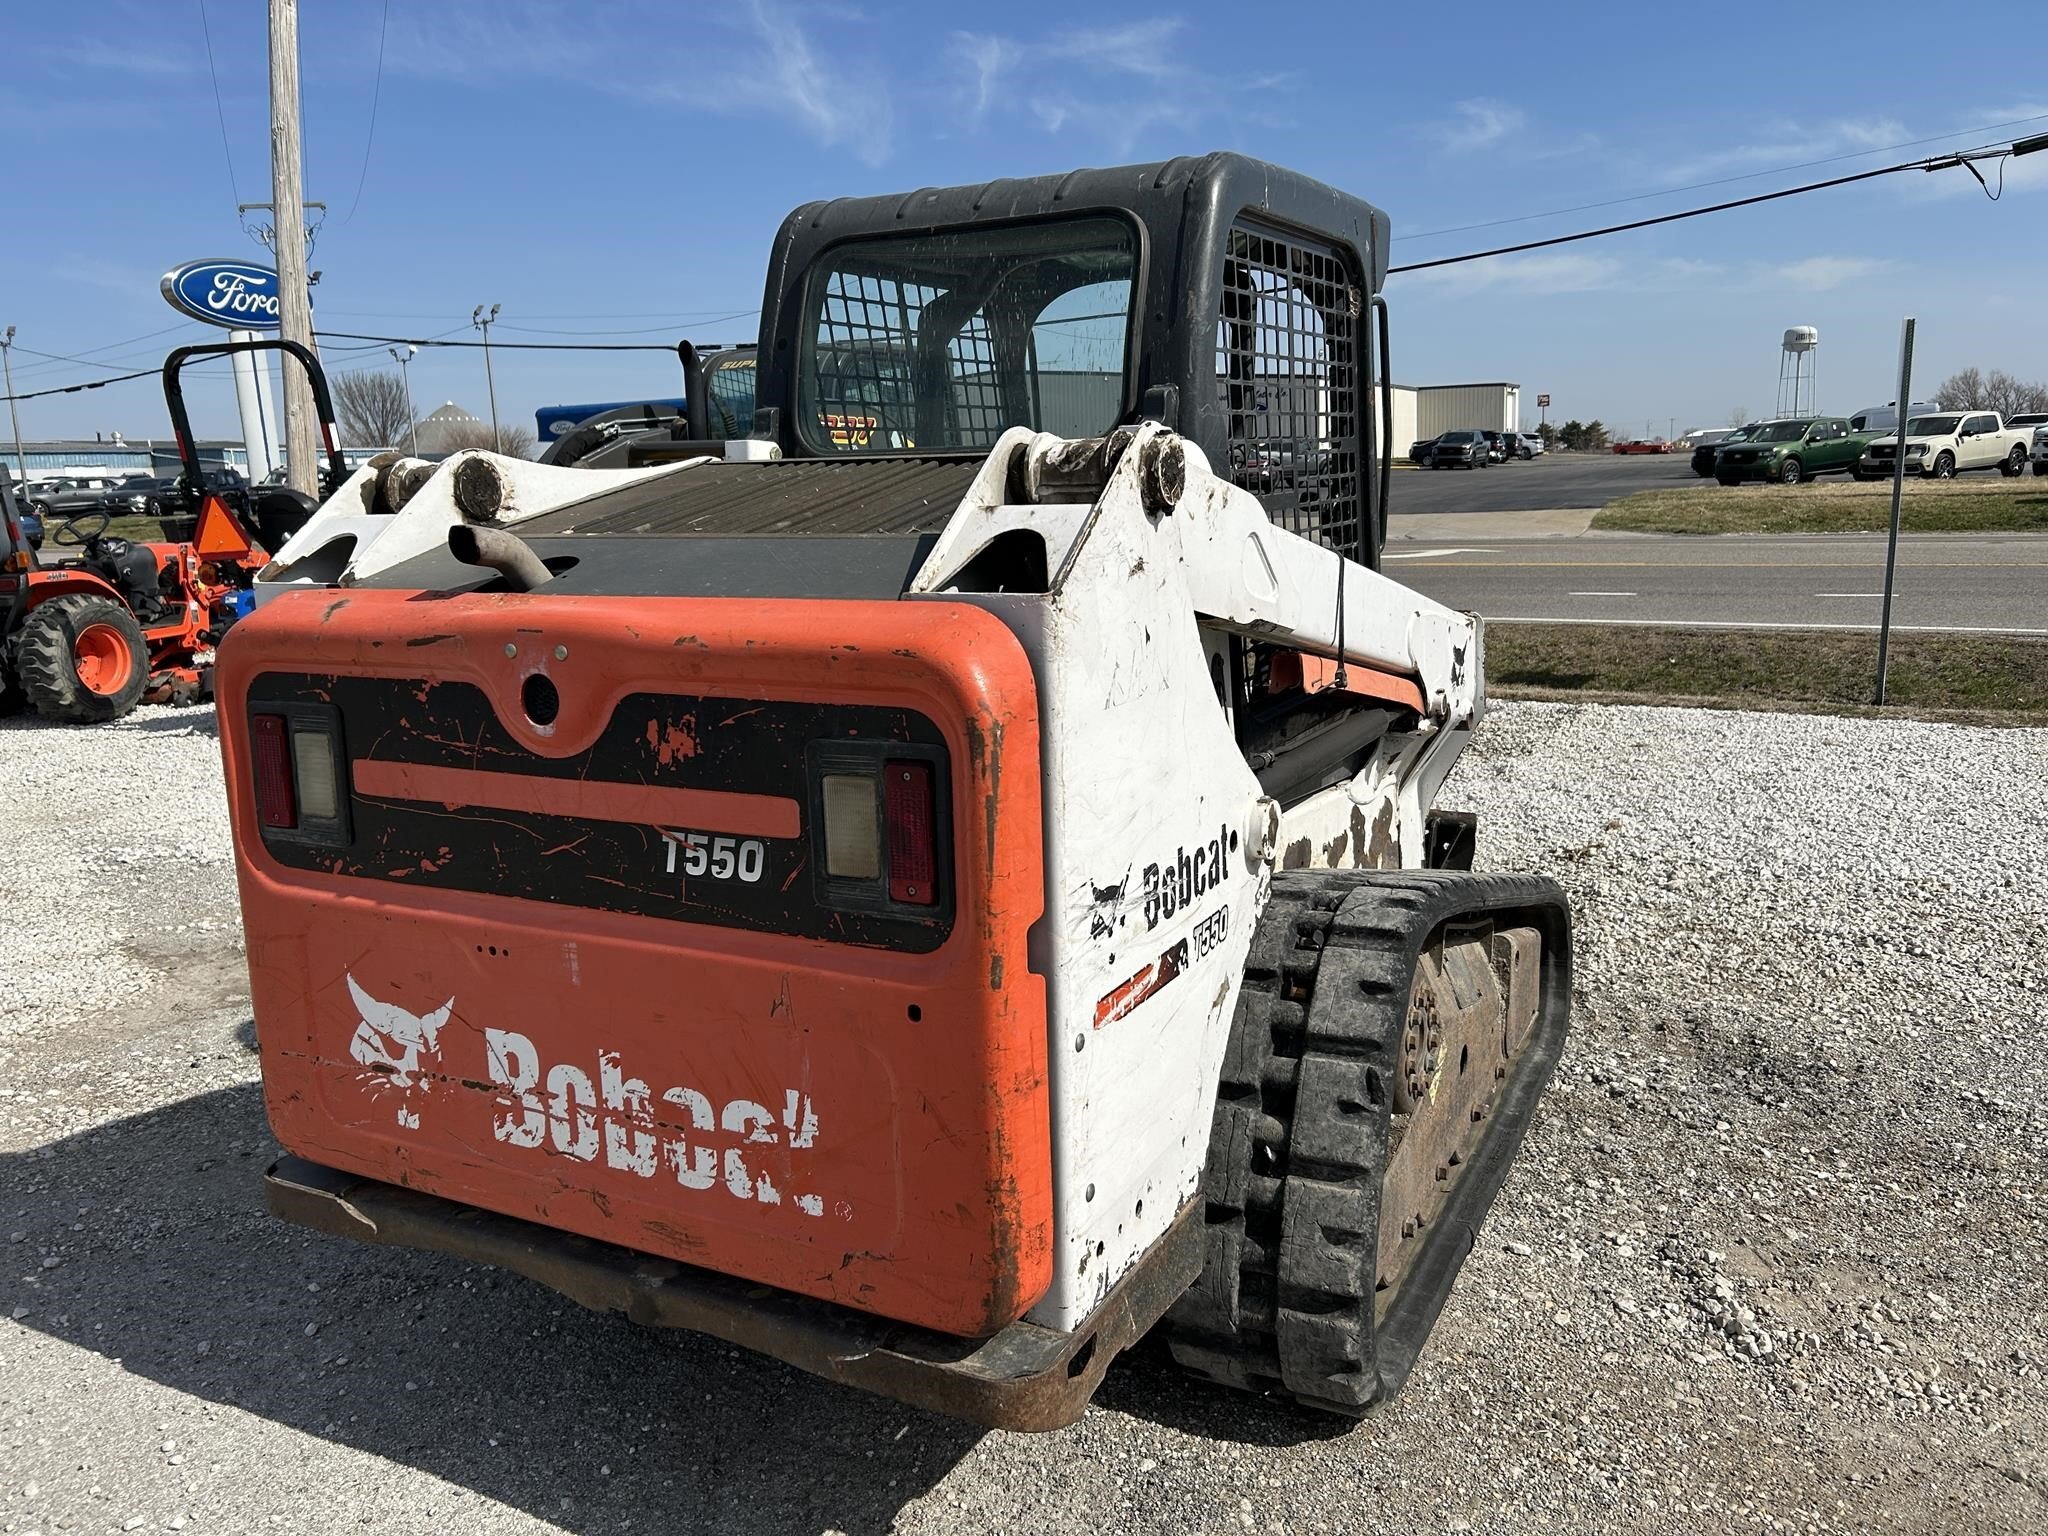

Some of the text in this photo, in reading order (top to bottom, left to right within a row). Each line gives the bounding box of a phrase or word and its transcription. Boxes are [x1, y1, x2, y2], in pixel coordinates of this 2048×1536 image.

[662, 831, 765, 882] T550
[1143, 823, 1229, 932] Bobcat
[1193, 904, 1229, 962] T550
